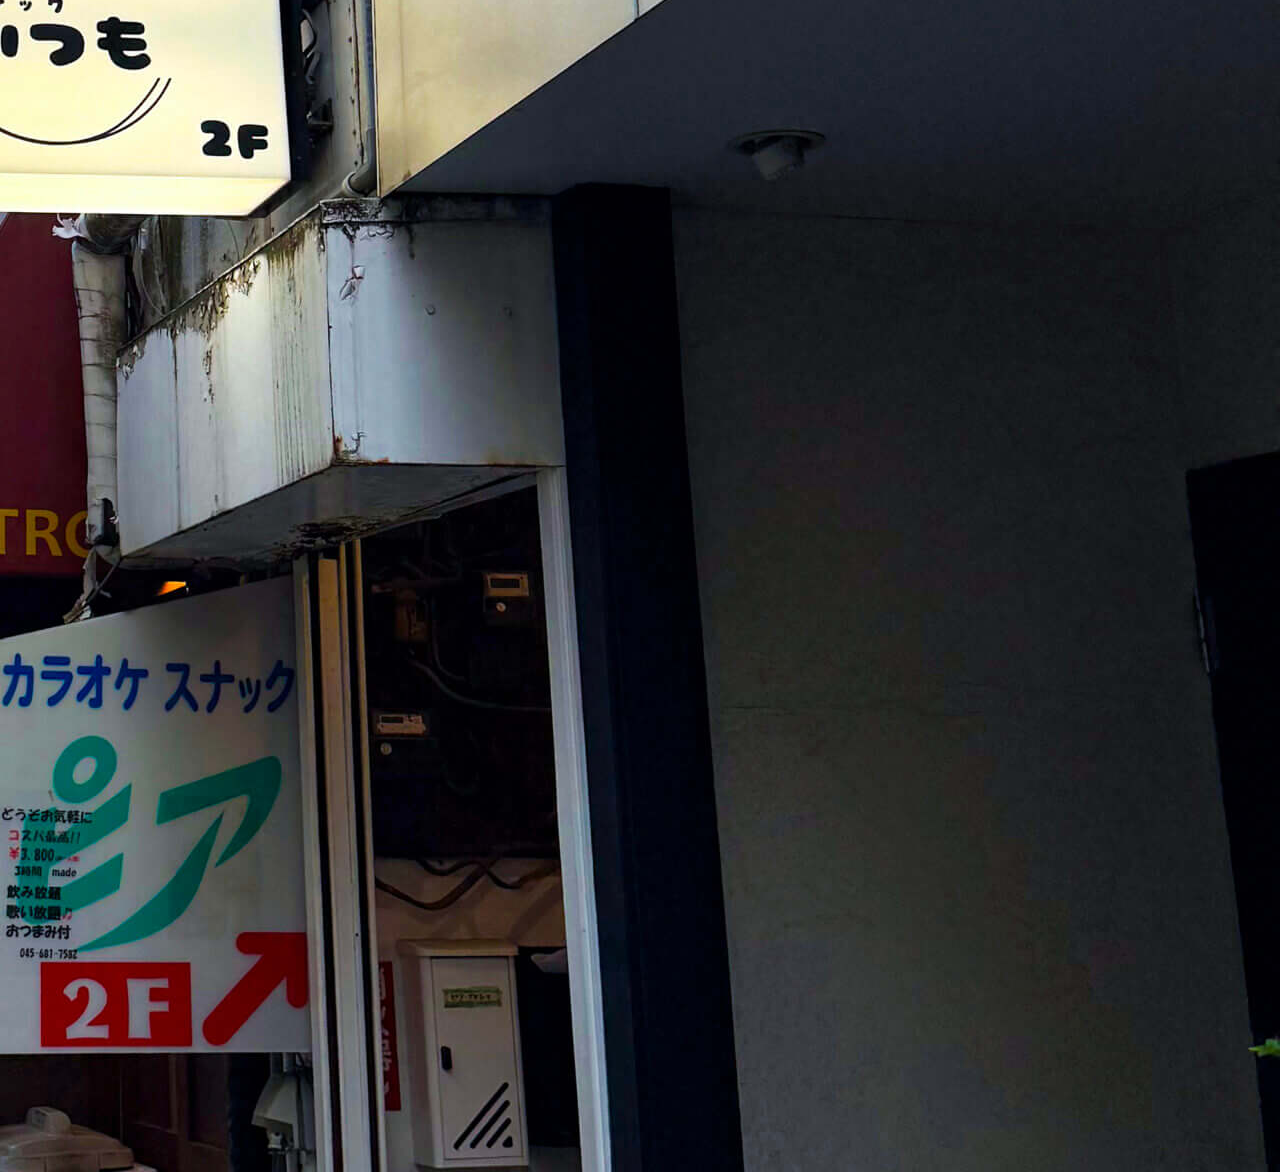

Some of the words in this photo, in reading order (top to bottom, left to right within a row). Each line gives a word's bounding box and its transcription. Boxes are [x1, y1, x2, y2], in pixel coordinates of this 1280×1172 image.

[201, 120, 268, 159] 2F
[1, 654, 147, 710] カラオケ
[164, 659, 295, 714] スナック
[17, 735, 282, 952] ピア
[52, 868, 77, 878] made
[6, 924, 71, 939] おつまみ付
[62, 976, 170, 1040] 2F
